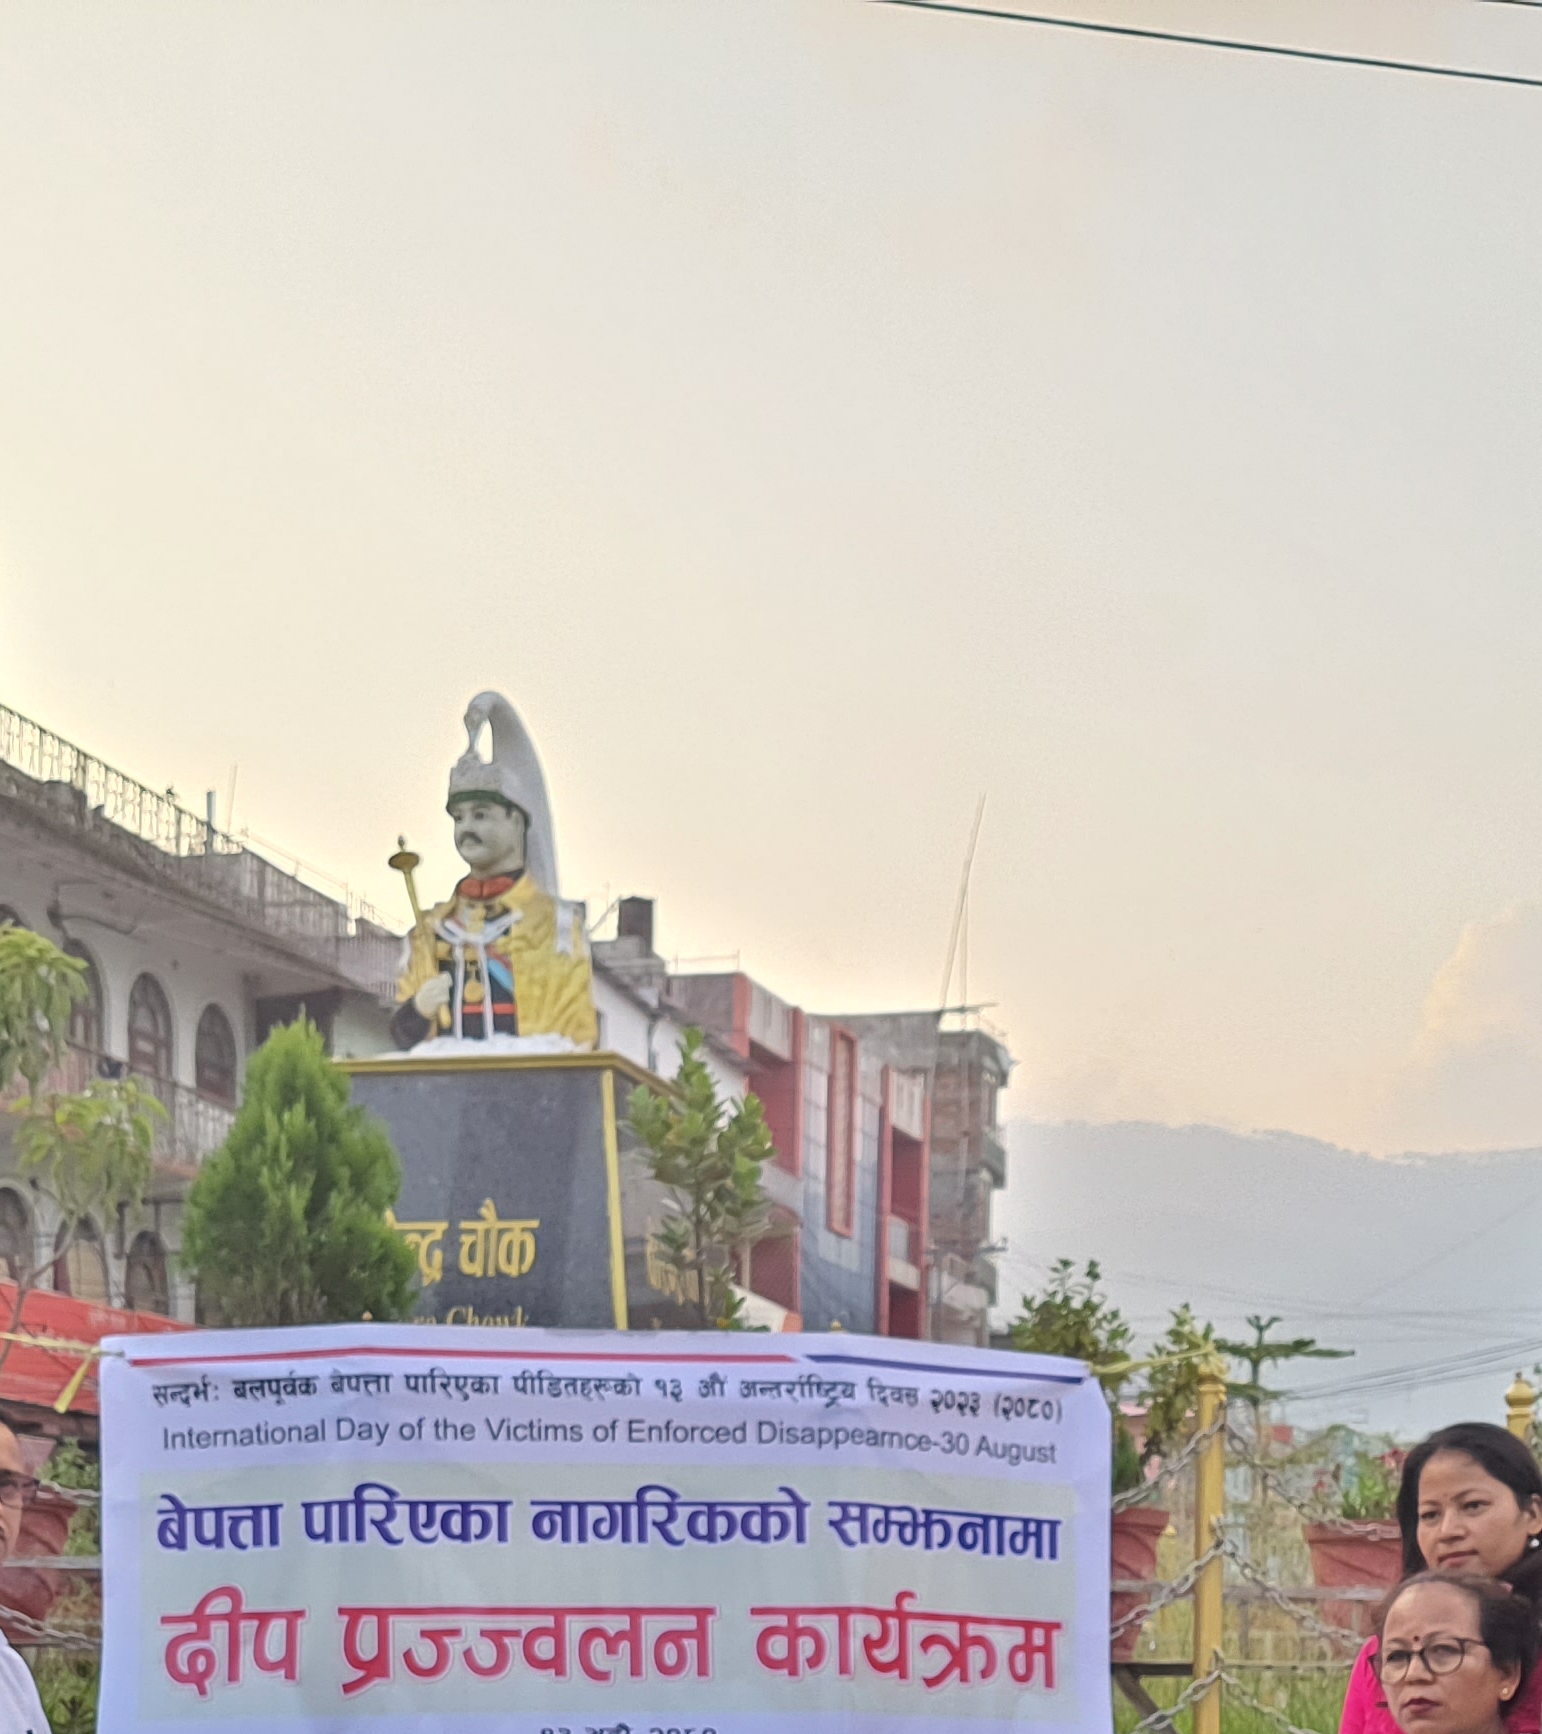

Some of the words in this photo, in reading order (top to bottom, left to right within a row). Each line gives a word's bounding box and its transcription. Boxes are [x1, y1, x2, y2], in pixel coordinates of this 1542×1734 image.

[458, 1197, 541, 1278] चौक
[232, 1369, 319, 1406] बलपूर्वक
[329, 1367, 394, 1396] बेपत्ता
[403, 1366, 502, 1402] पारिएका
[654, 1377, 684, 1403] १३
[866, 1376, 921, 1408] दिवस
[930, 1388, 982, 1417] २०२३
[993, 1393, 1063, 1425] (२०८०)
[163, 1418, 327, 1451] International
[335, 1416, 390, 1447] Day
[399, 1416, 425, 1442] of
[433, 1416, 477, 1443] the
[485, 1416, 584, 1443] Victims
[593, 1419, 620, 1443] of
[628, 1419, 748, 1445] Enforced
[975, 1435, 1058, 1467] August
[157, 1493, 283, 1551] बेपत्ता
[301, 1483, 513, 1547] पारिएका
[530, 1484, 812, 1548] नागरिकको
[827, 1499, 1062, 1561] सम्झनामा
[160, 1585, 307, 1699] दीप
[338, 1605, 718, 1696] प्रज्ज्वलन
[750, 1589, 1062, 1691] कार्यक्रम
